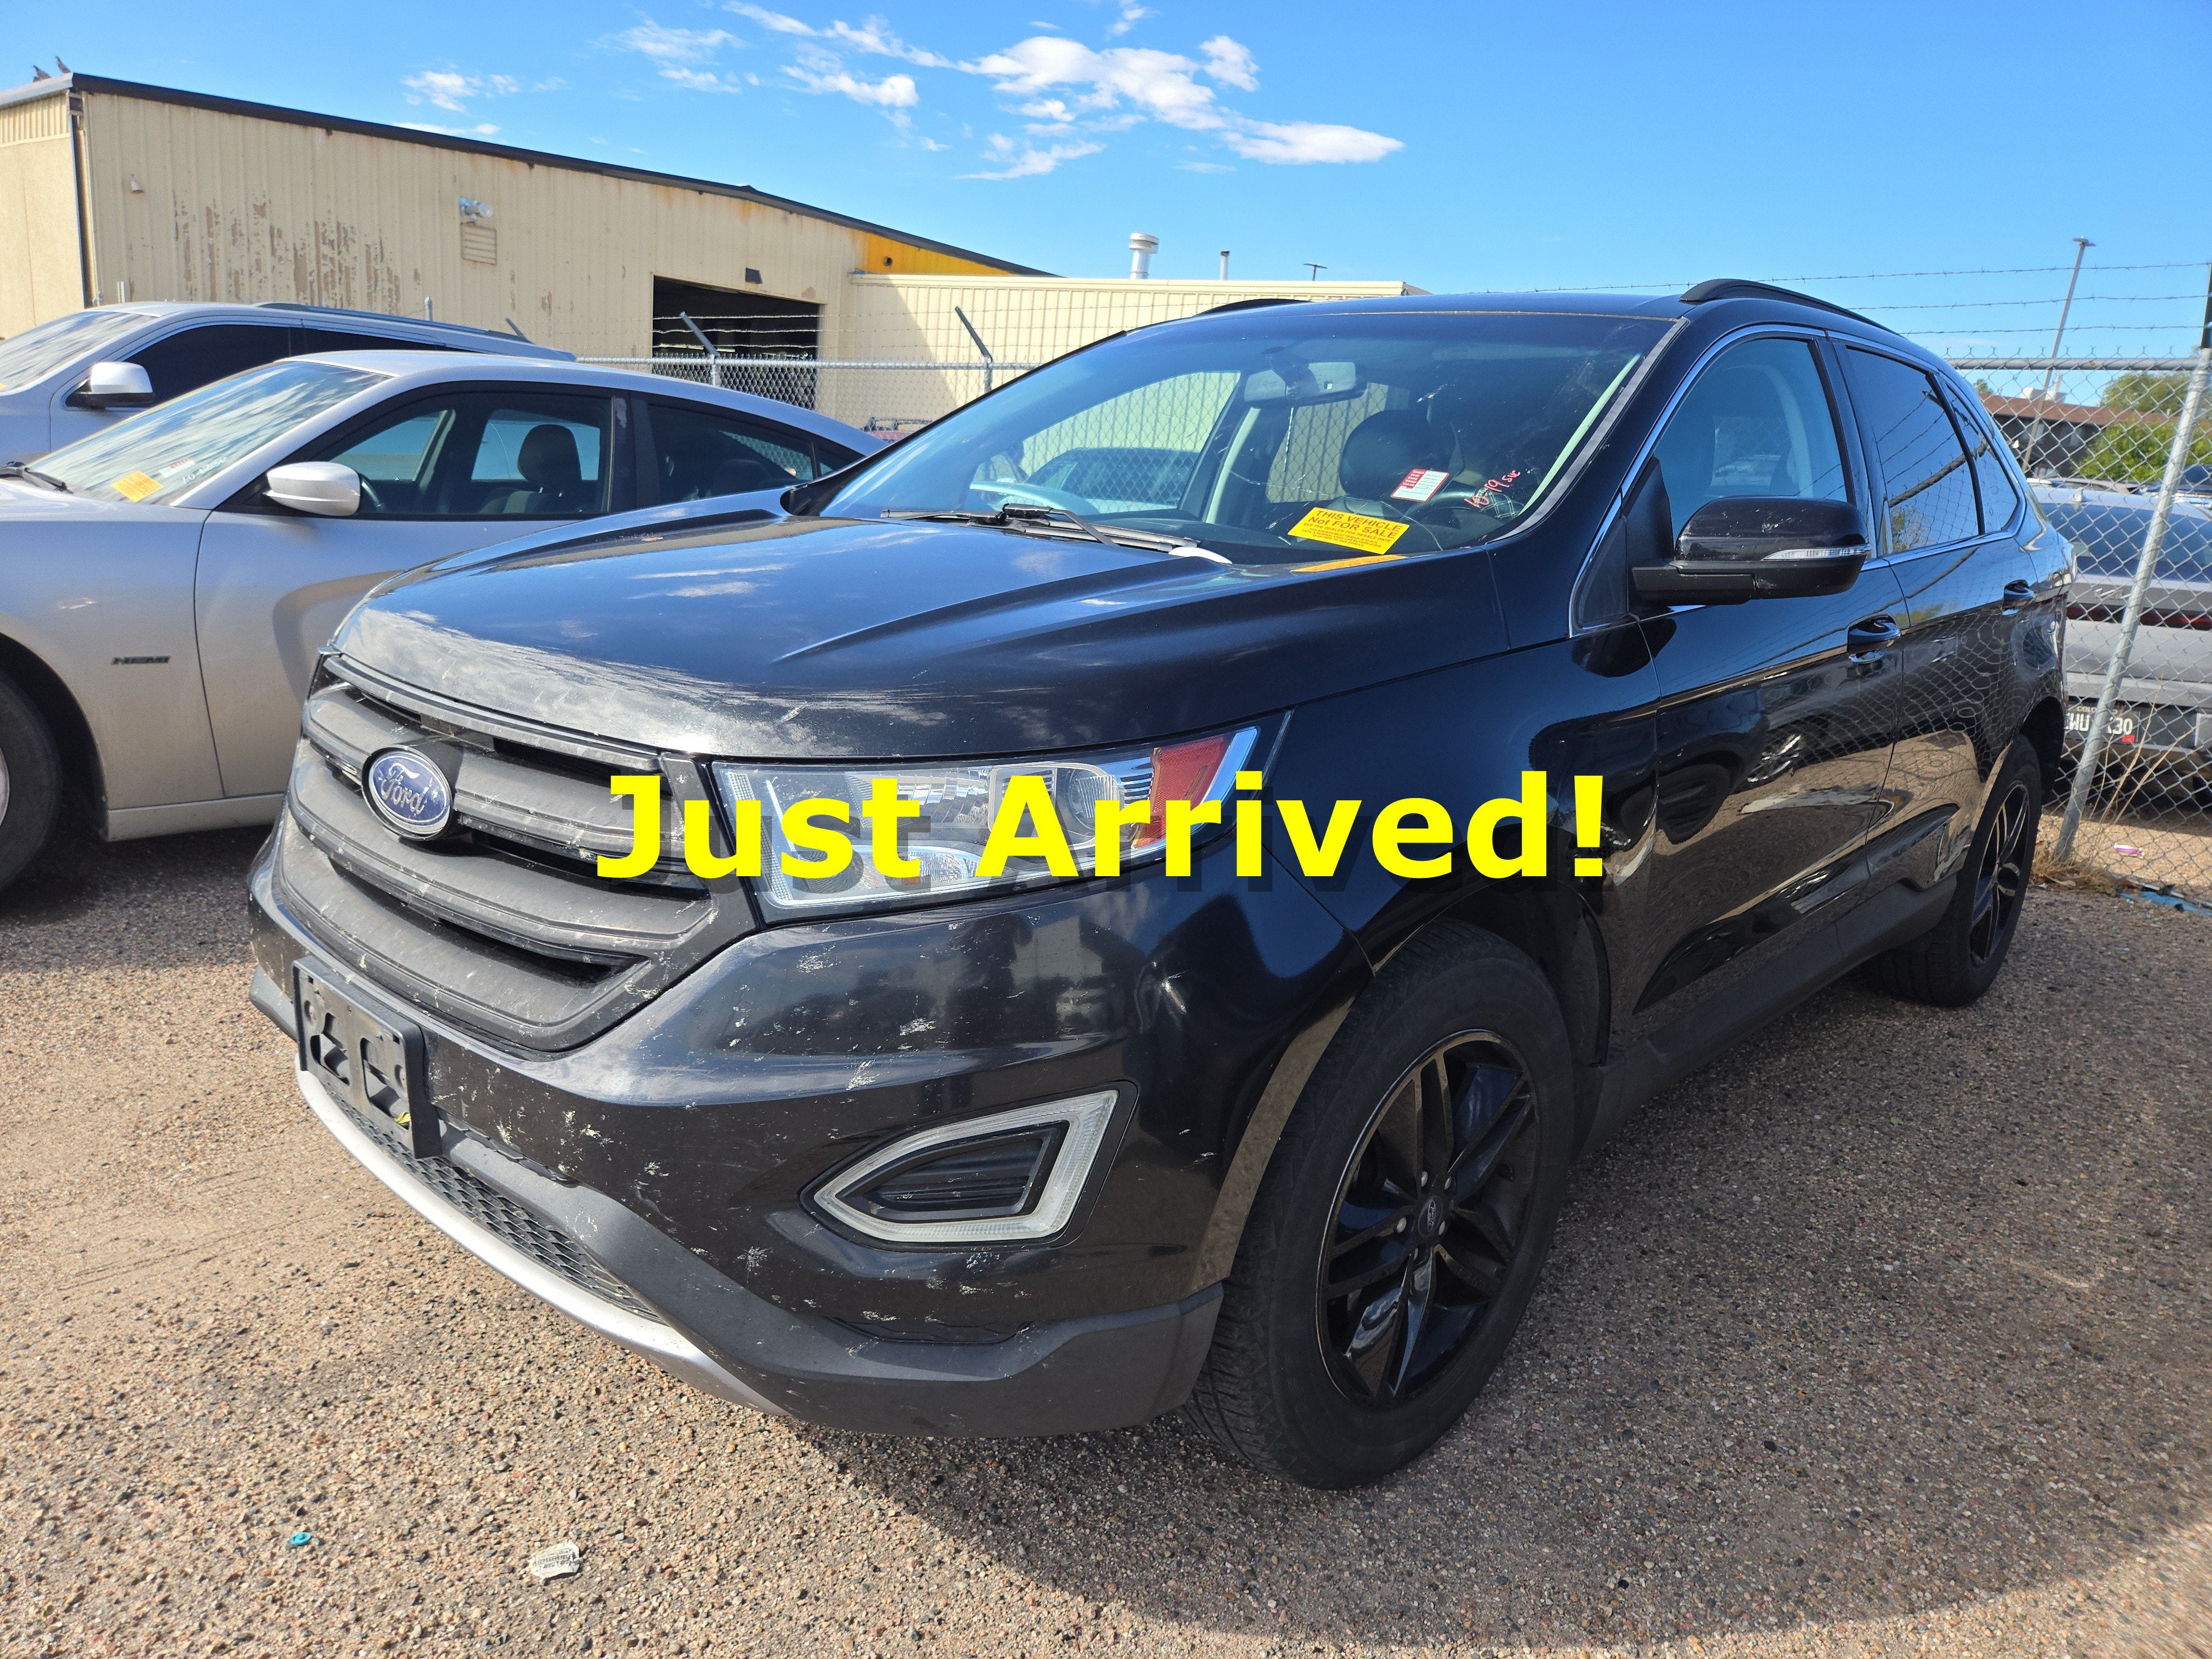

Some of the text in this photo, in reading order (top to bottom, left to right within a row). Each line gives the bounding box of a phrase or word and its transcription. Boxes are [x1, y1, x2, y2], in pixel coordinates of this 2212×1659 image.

[1308, 516, 1398, 539] Not FOR SALE
[1316, 510, 1403, 532] THIS VEHICLE
[378, 762, 429, 815] Ford
